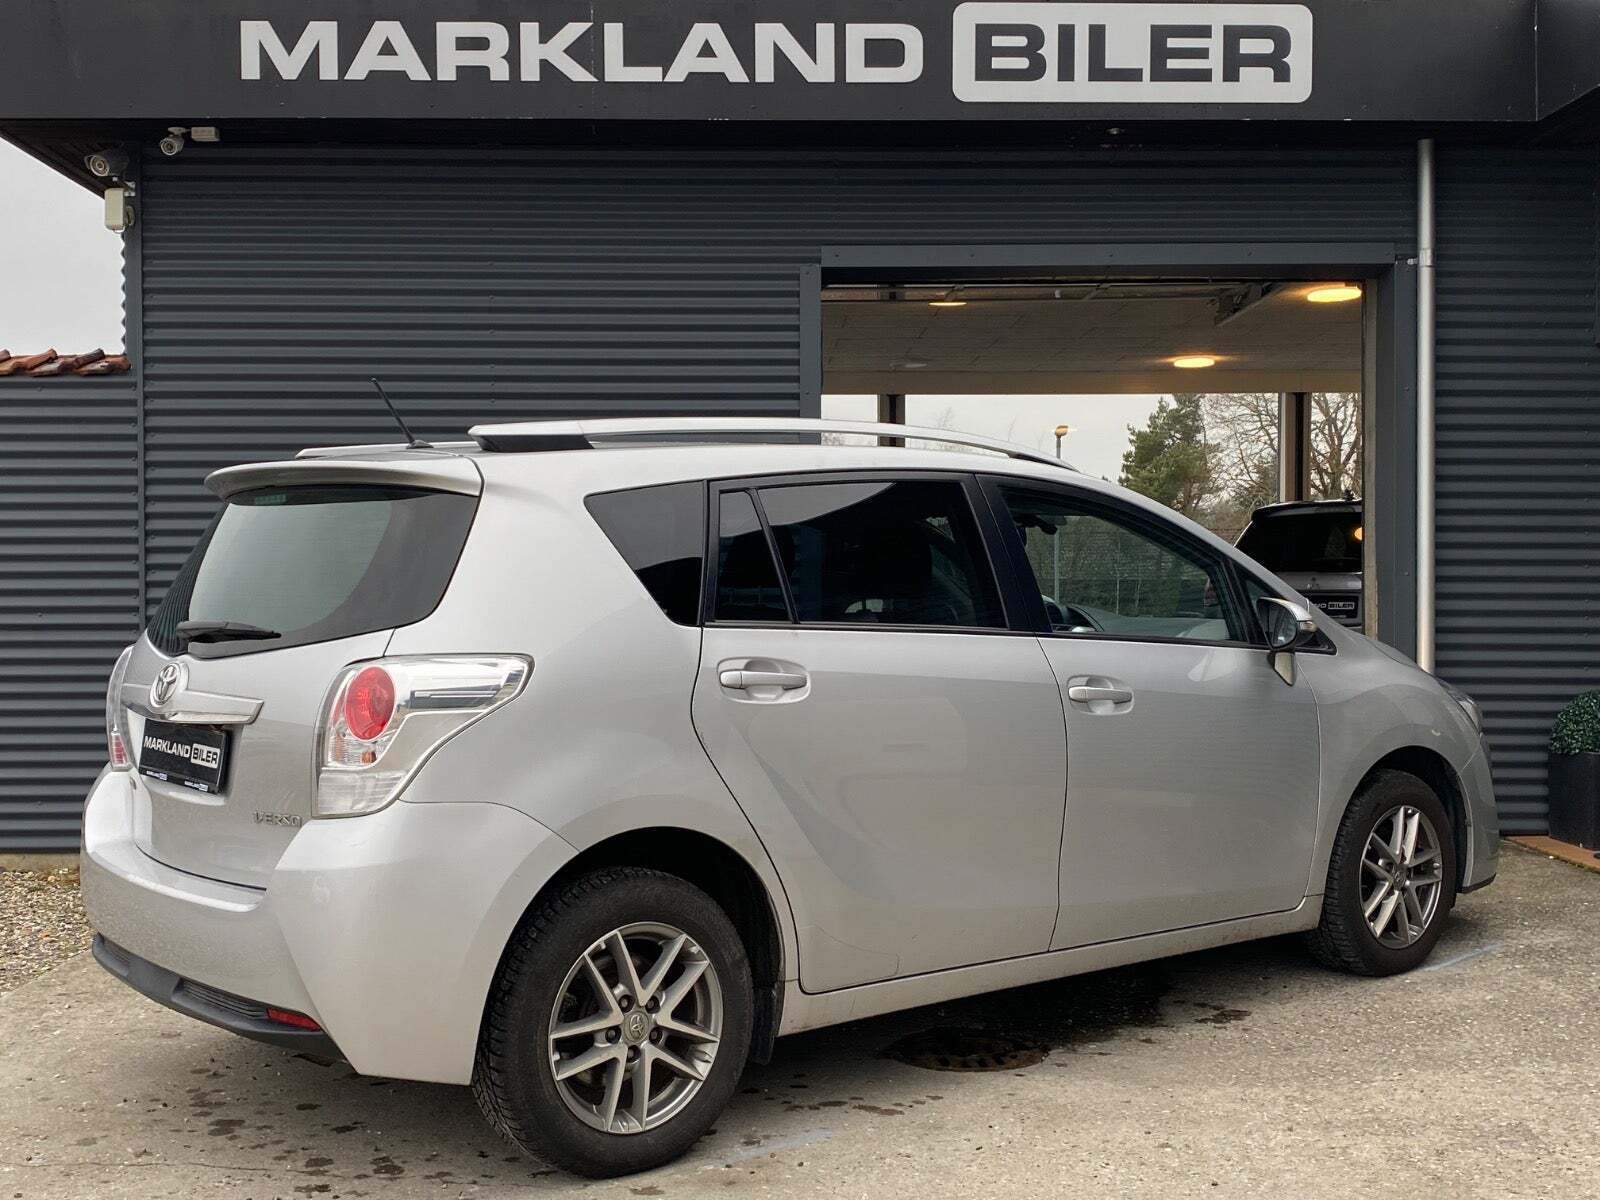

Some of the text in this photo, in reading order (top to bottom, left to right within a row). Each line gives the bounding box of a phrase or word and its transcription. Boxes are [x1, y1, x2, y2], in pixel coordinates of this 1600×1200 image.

[240, 20, 1292, 83] MARKLAND BILER
[143, 735, 219, 765] MARKLAND BILER
[253, 811, 302, 827] VERSO
